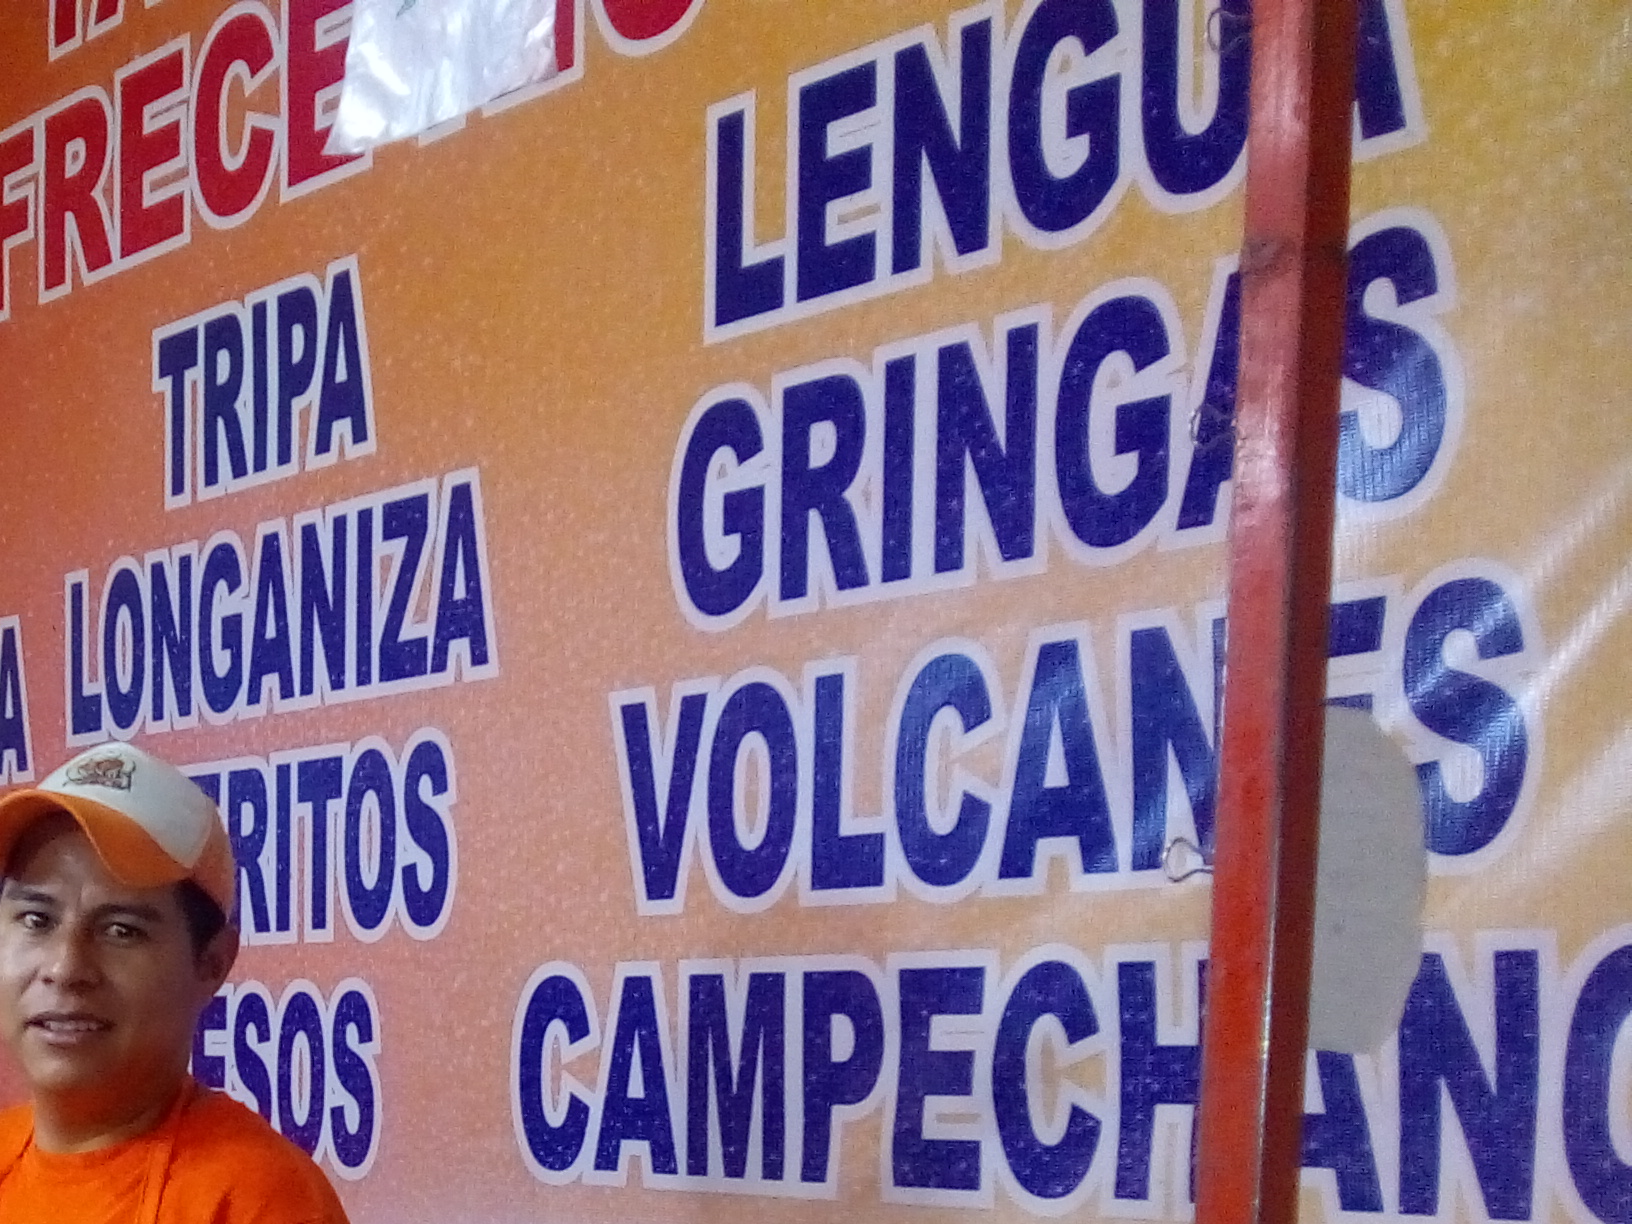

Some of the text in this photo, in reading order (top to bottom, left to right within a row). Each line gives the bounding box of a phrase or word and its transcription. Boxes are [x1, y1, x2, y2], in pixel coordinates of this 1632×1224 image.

[157, 262, 370, 500] TRIPA
[68, 476, 494, 738] LONGANIZA
[189, 738, 451, 931] RITOS
